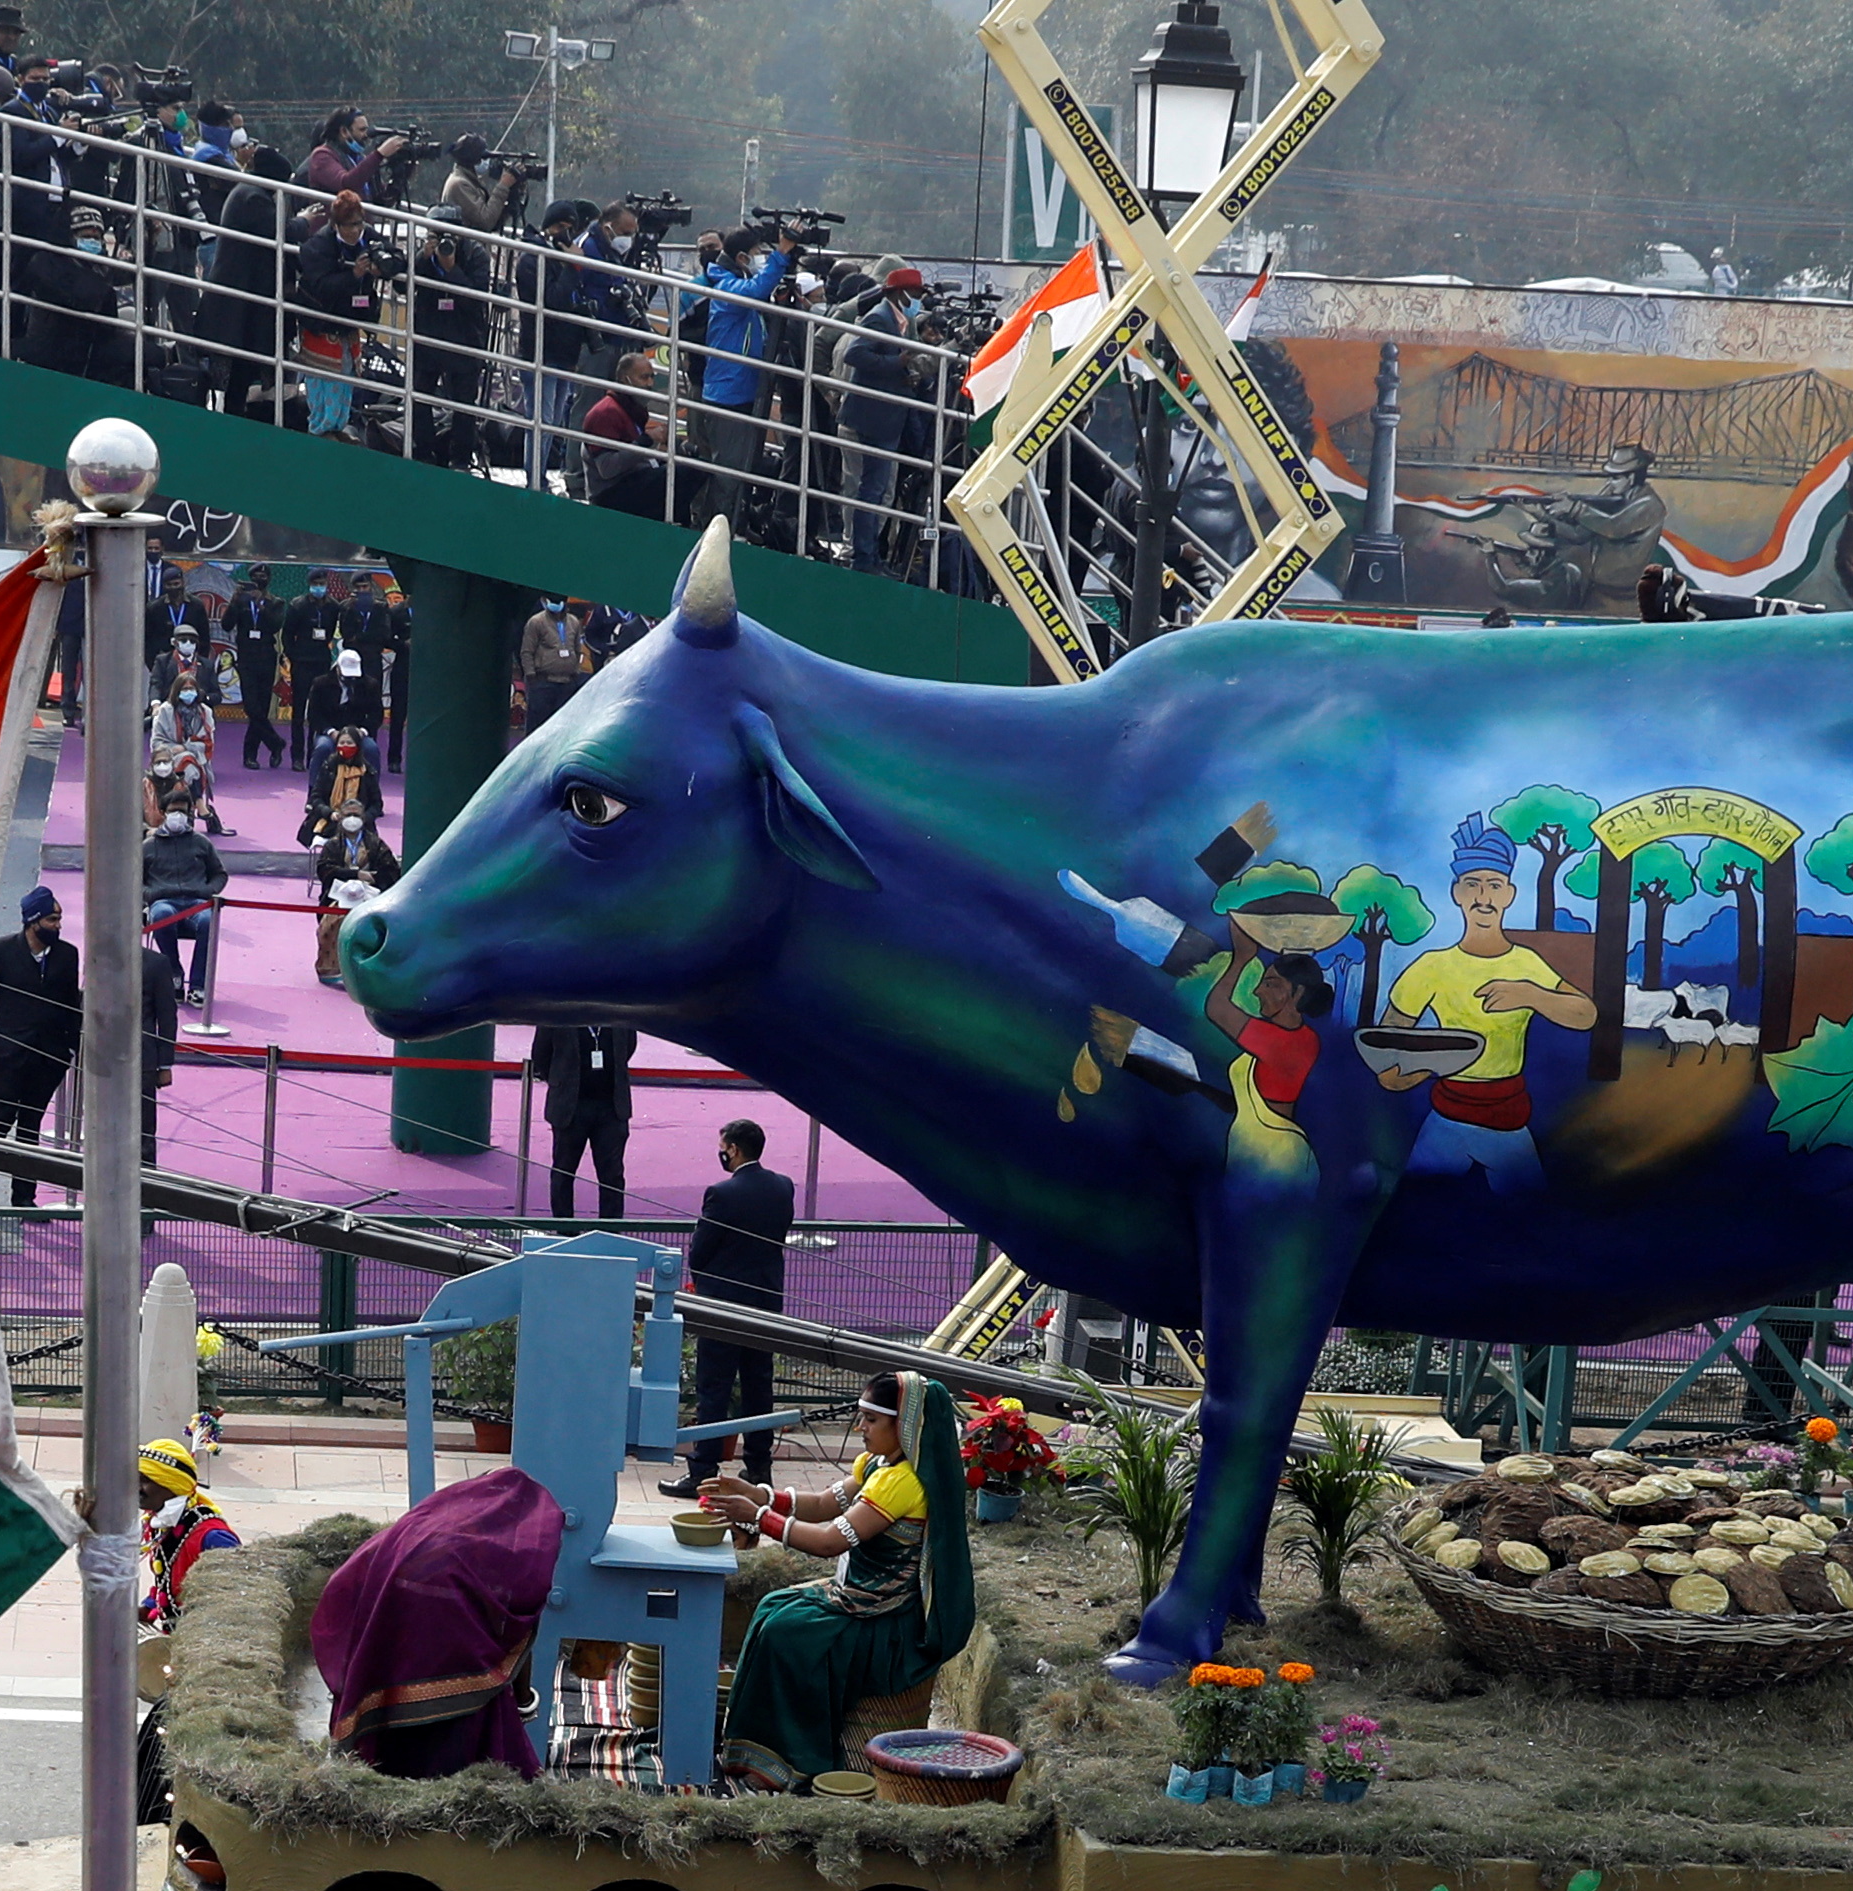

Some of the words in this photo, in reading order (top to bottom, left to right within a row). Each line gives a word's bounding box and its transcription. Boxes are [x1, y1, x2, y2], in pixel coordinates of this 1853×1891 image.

[1060, 101, 1140, 221] 18001025438
[1237, 90, 1333, 201] 18001025438
[1015, 358, 1104, 463] MANLIFT
[1232, 377, 1296, 462] ANLIFT
[1003, 547, 1079, 654] MANLIFT
[1238, 550, 1307, 620] UP.COM
